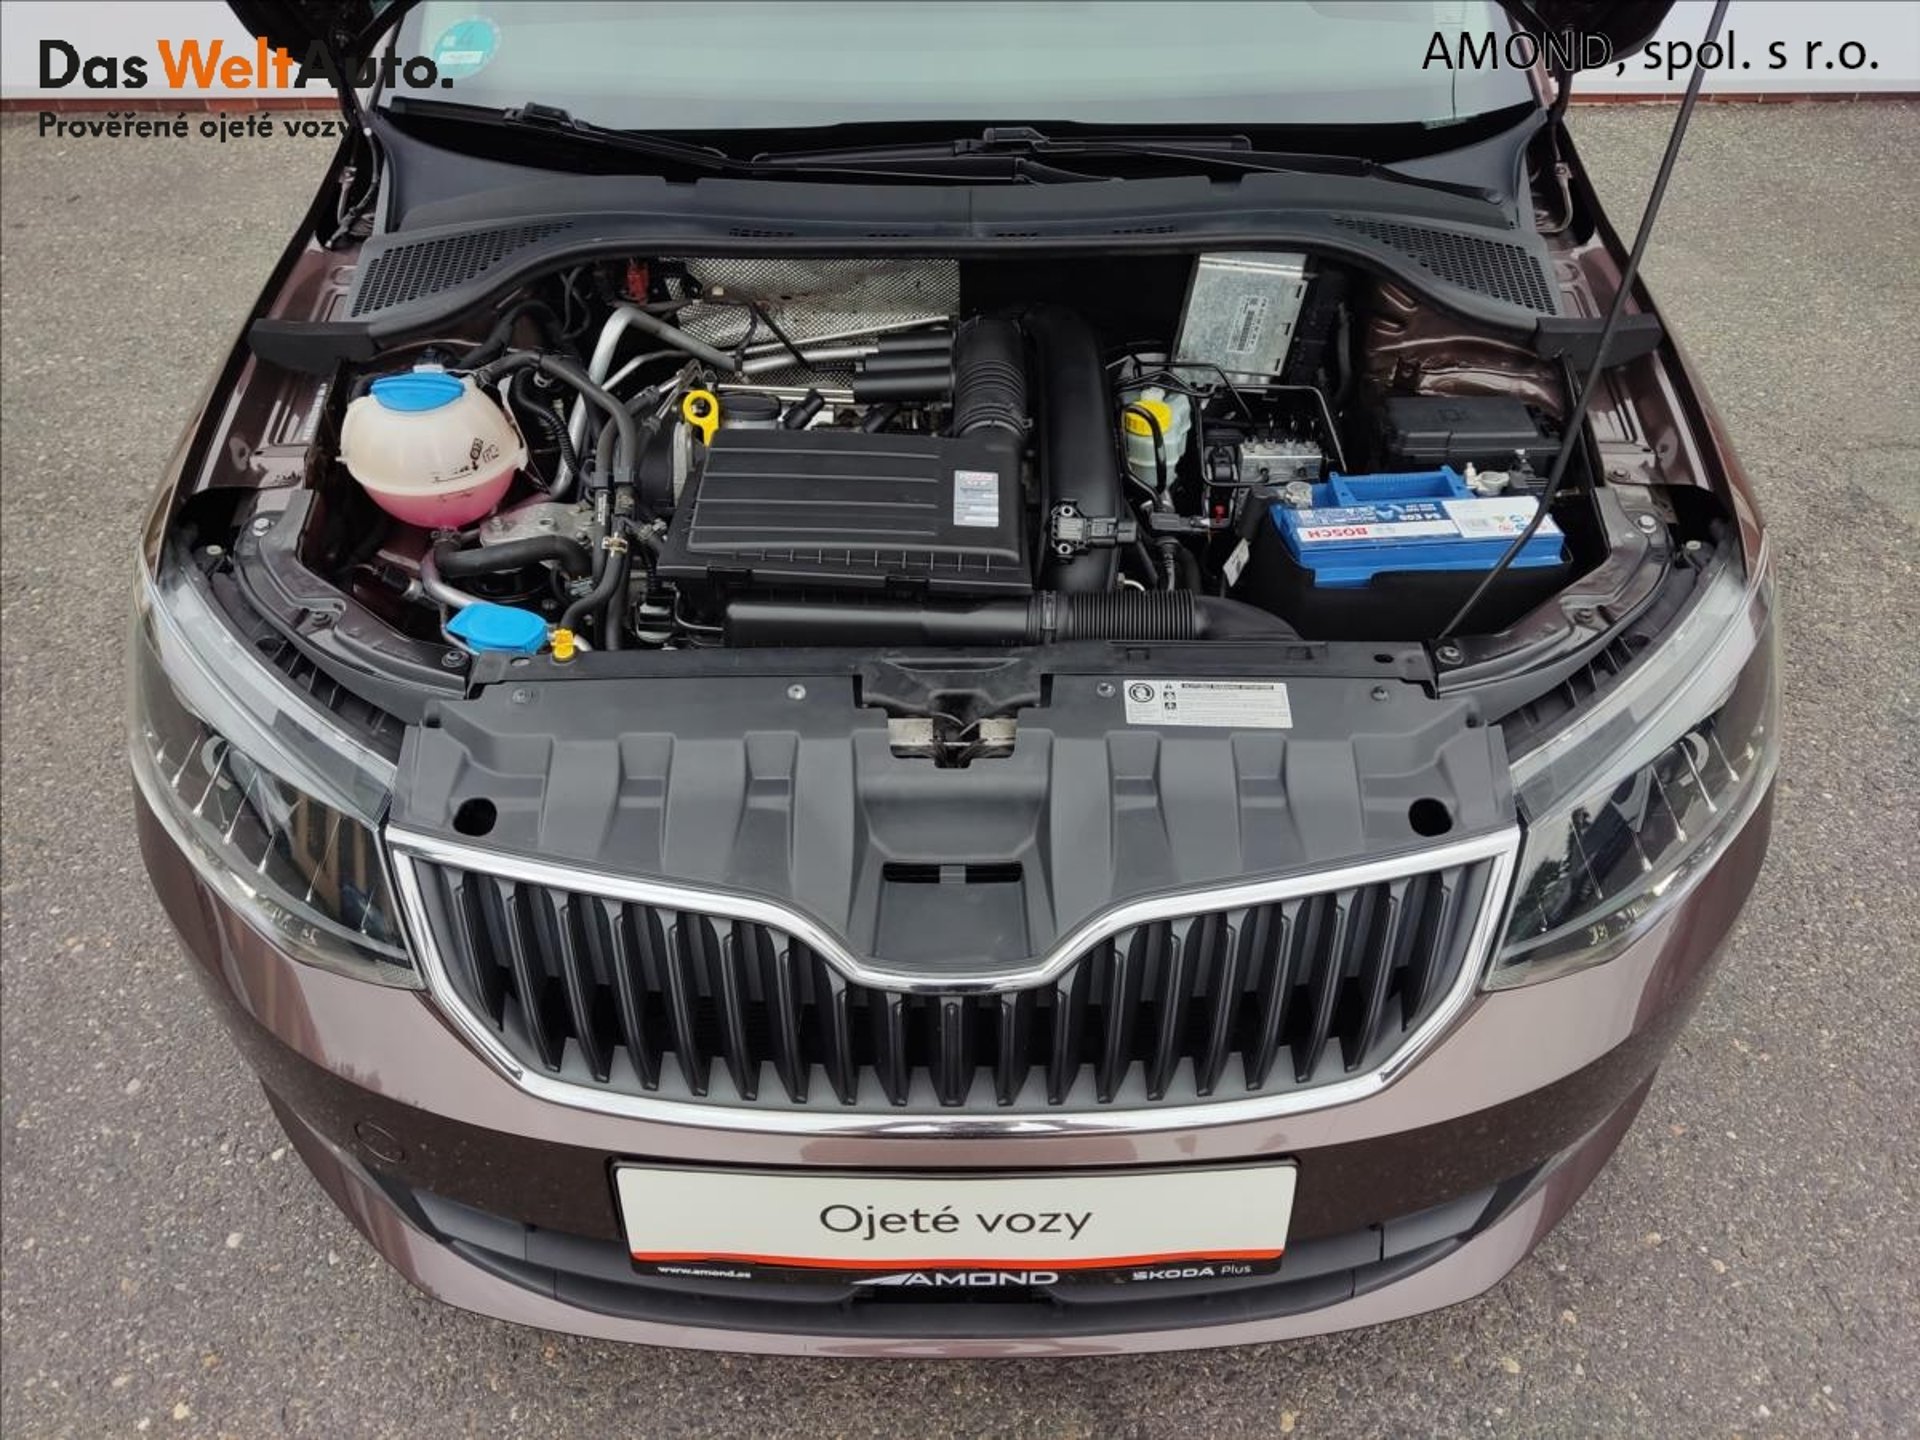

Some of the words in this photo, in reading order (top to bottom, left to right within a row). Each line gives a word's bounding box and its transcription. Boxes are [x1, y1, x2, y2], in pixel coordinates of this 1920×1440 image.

[1307, 527, 1368, 538] BOSCH
[820, 1204, 960, 1241] Ojeté
[976, 1212, 1093, 1241] vozy
[904, 1271, 1059, 1286] AMOND
